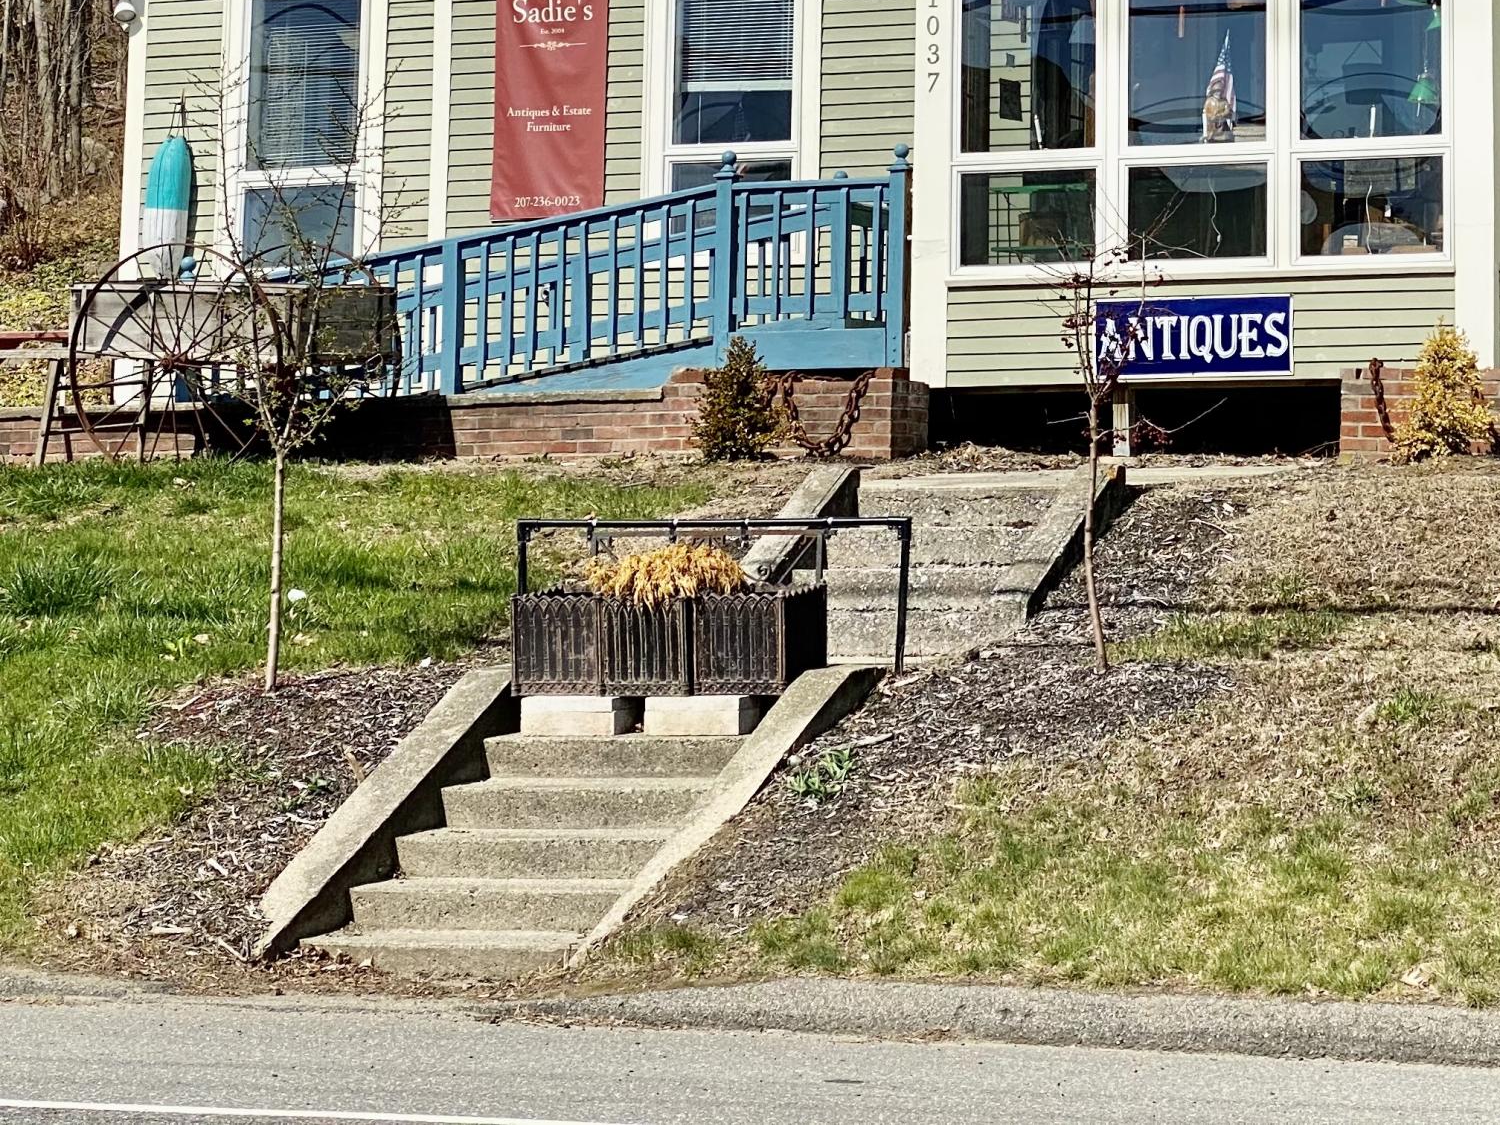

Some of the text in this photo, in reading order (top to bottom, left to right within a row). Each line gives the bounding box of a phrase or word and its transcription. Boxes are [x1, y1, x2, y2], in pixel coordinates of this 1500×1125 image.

[506, 104, 592, 120] Antiques & Estate
[526, 121, 572, 132] Furniture
[514, 195, 580, 208] 207-236-0023
[1098, 312, 1288, 363] ANTIQUES
